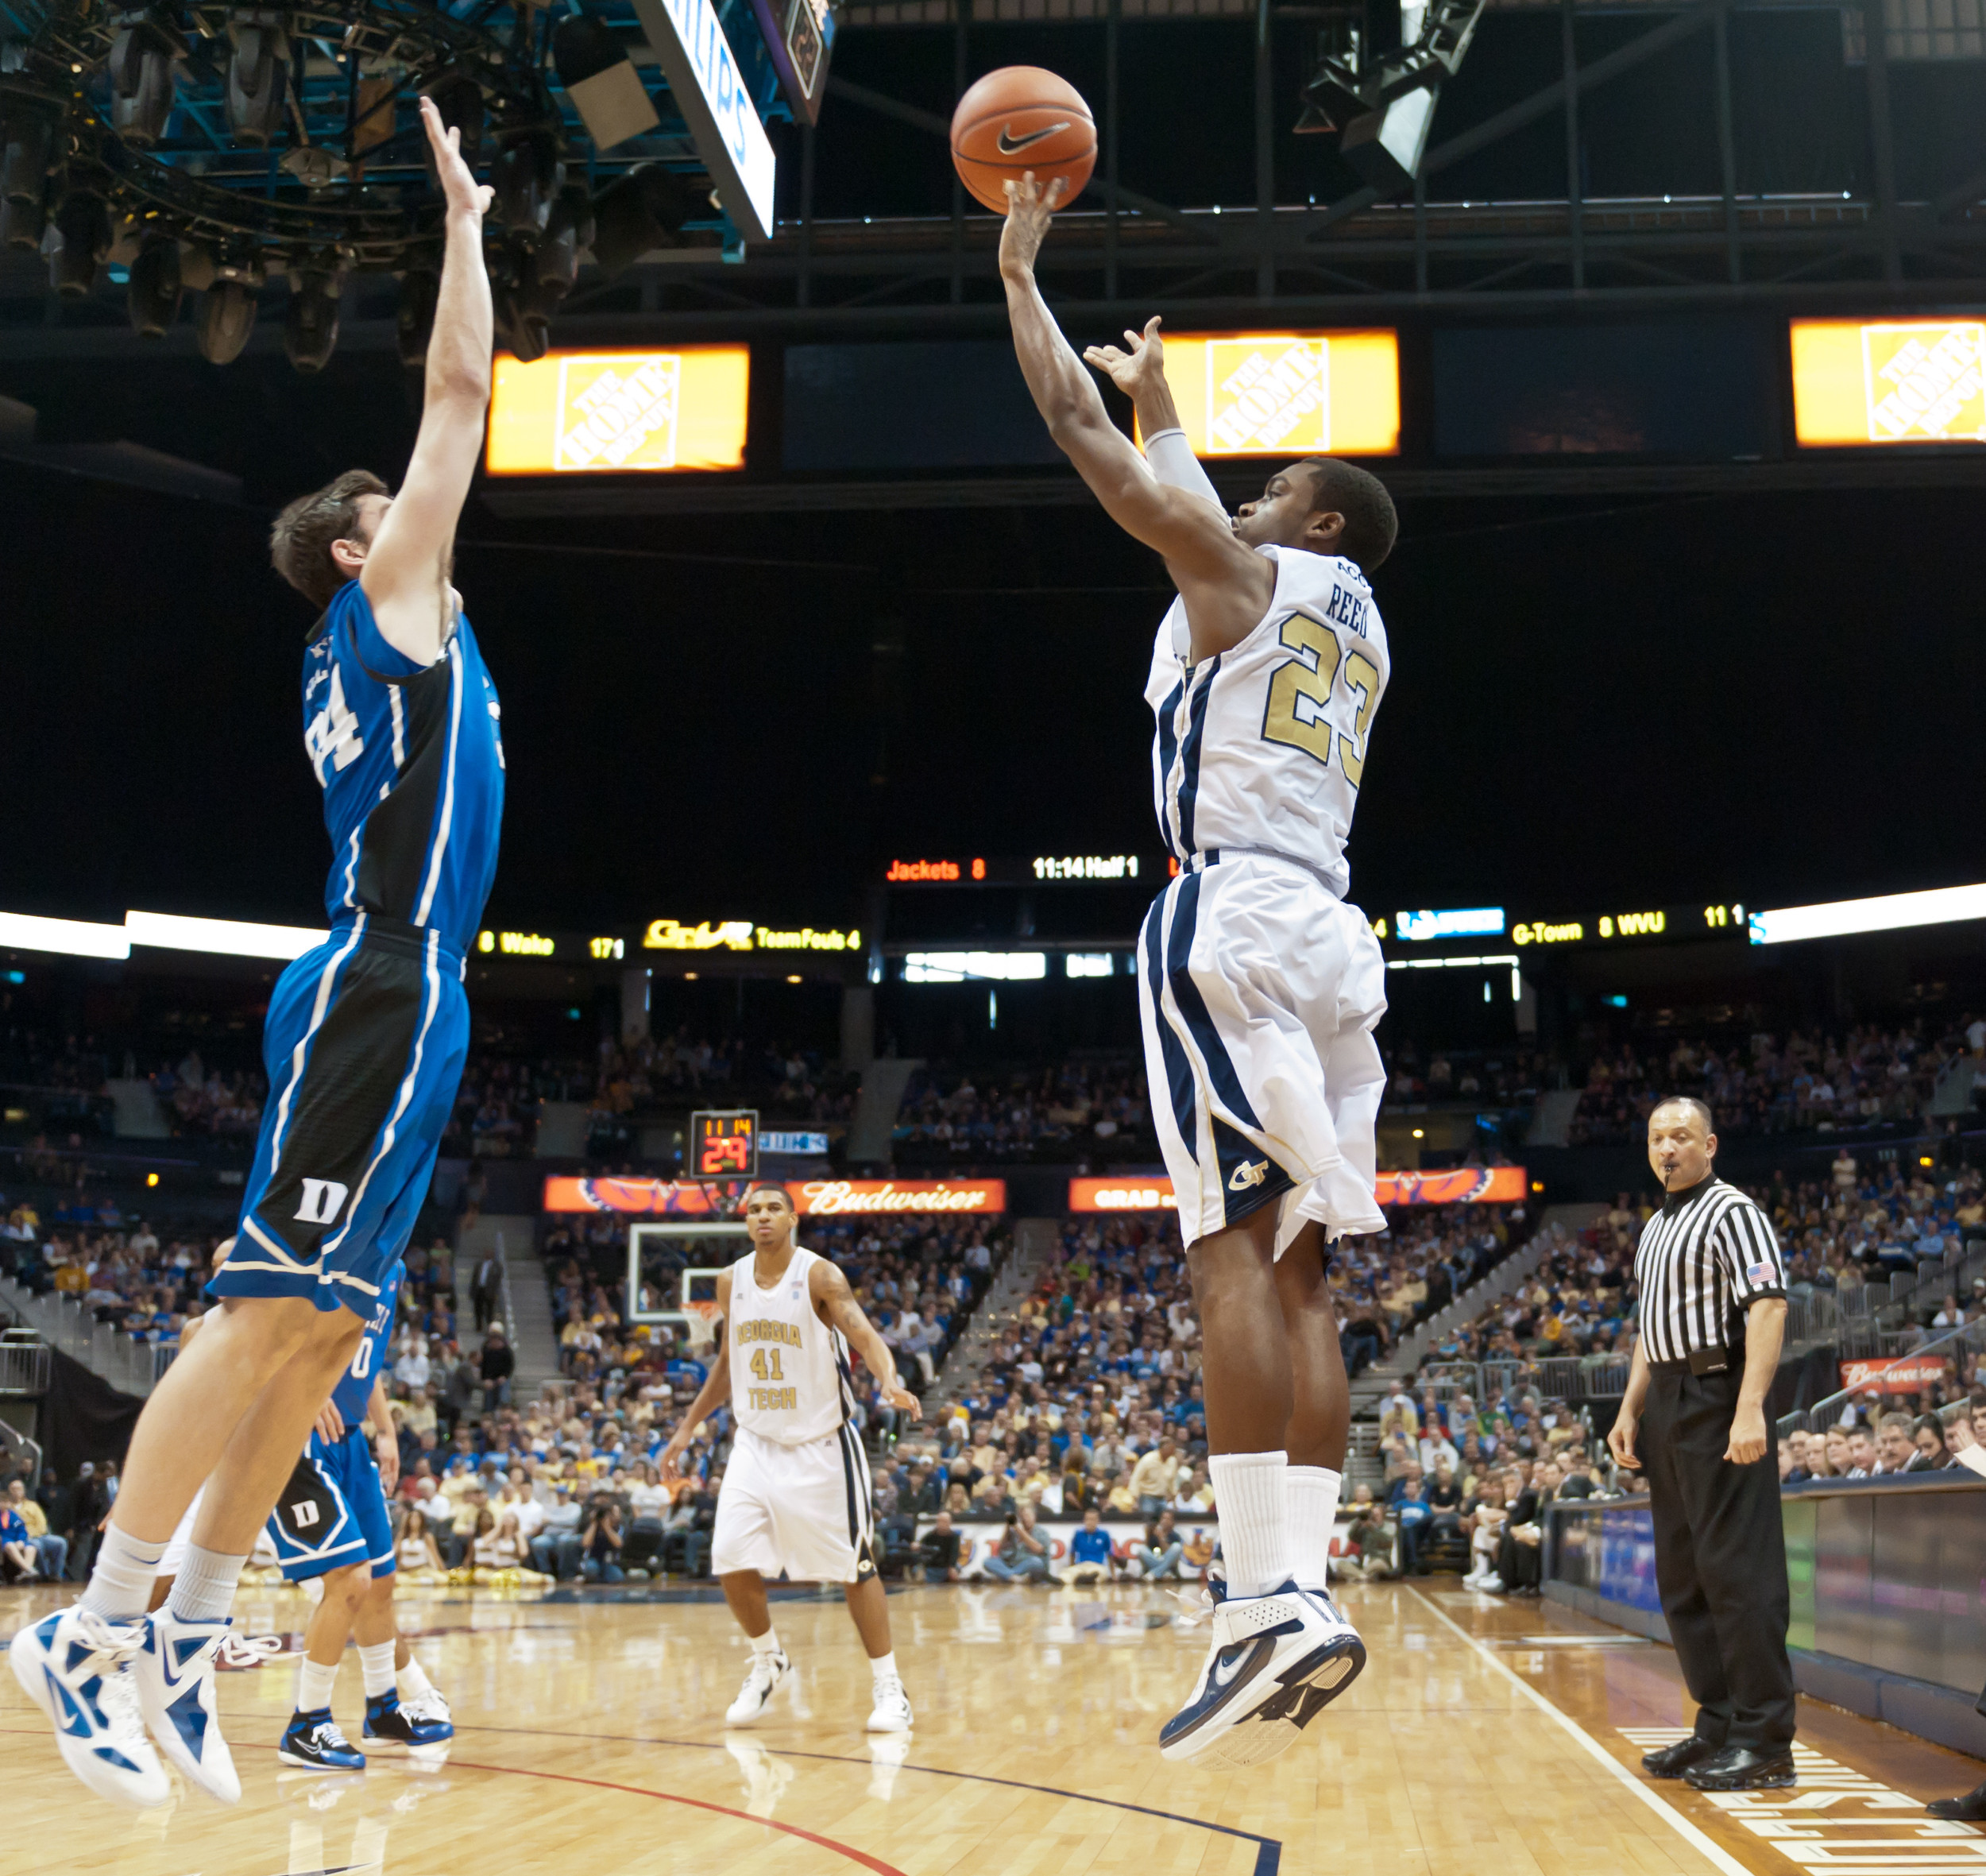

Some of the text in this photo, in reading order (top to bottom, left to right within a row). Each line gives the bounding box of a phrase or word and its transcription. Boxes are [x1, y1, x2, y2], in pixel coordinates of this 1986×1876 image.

[1220, 351, 1271, 396] THE
[1873, 329, 1980, 438] HOME
[1212, 341, 1324, 448] HOME
[562, 359, 674, 466] HOME
[1255, 378, 1324, 448] DEPOT
[1261, 611, 1380, 791] 23
[887, 860, 959, 880] Jackets
[1033, 855, 1139, 879] 11:14 Half 1
[846, 930, 861, 950] 4
[1513, 923, 1582, 945] G-Town
[1617, 911, 1665, 935] WVU
[701, 1136, 747, 1173] 29
[292, 1178, 349, 1224] D
[802, 1181, 986, 1214] Budweiser
[1095, 1189, 1160, 1208] GRAB
[736, 1319, 802, 1348] GEORGIA
[750, 1348, 784, 1380] 41
[748, 1387, 797, 1410] TECH
[290, 1499, 319, 1528] D
